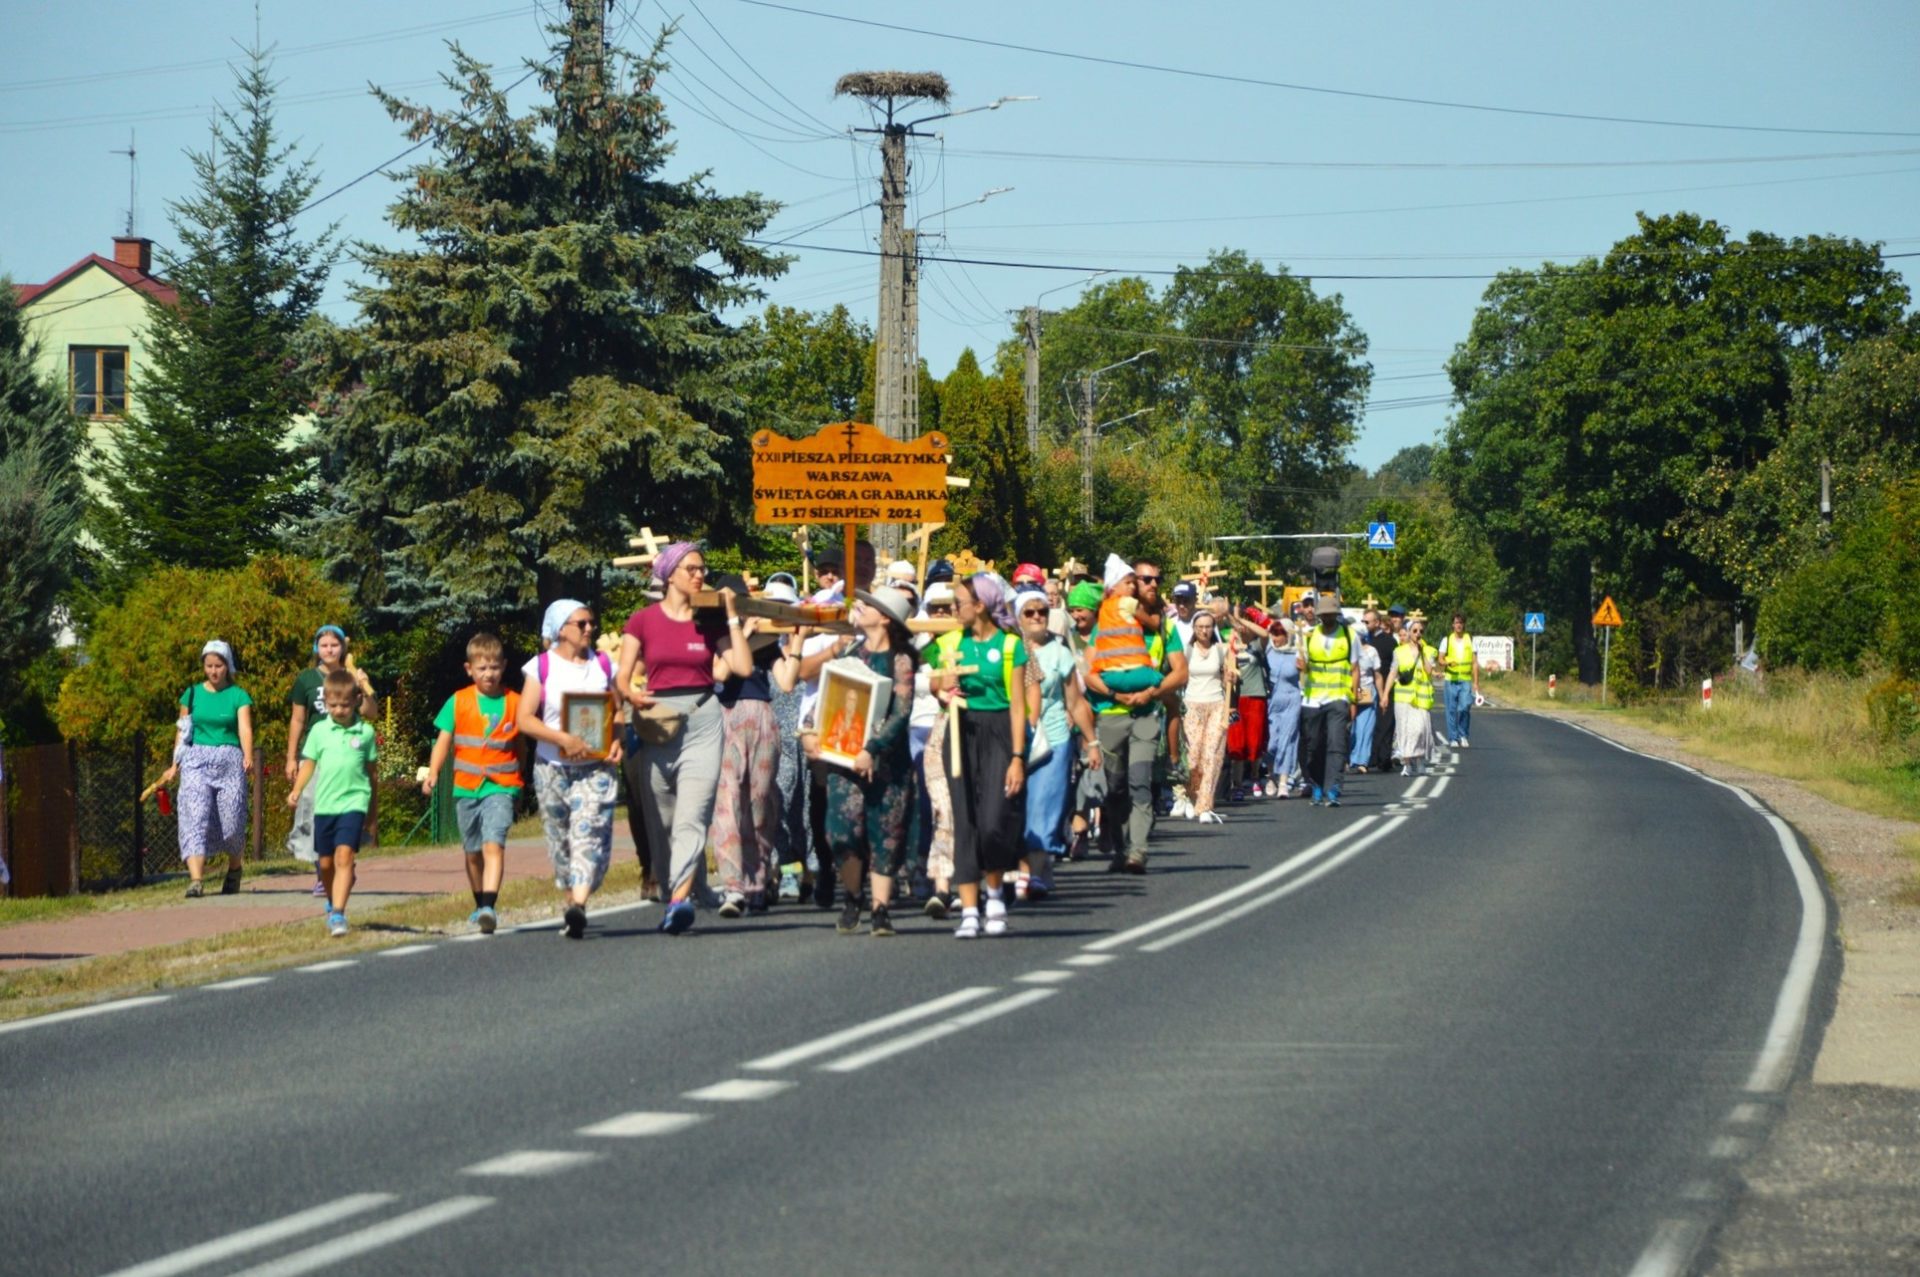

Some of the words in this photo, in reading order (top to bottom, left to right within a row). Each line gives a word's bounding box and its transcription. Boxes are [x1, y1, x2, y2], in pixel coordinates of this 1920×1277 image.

[757, 452, 780, 463] XXII
[782, 451, 834, 463] PIESZA
[838, 452, 947, 463] PIELGRZYMKA
[807, 471, 892, 482] WARSZAWA
[754, 487, 812, 501] ŚWIĘTA
[815, 487, 857, 499] GÓRA
[861, 490, 949, 500] GRABARKA
[887, 508, 921, 519] 2024
